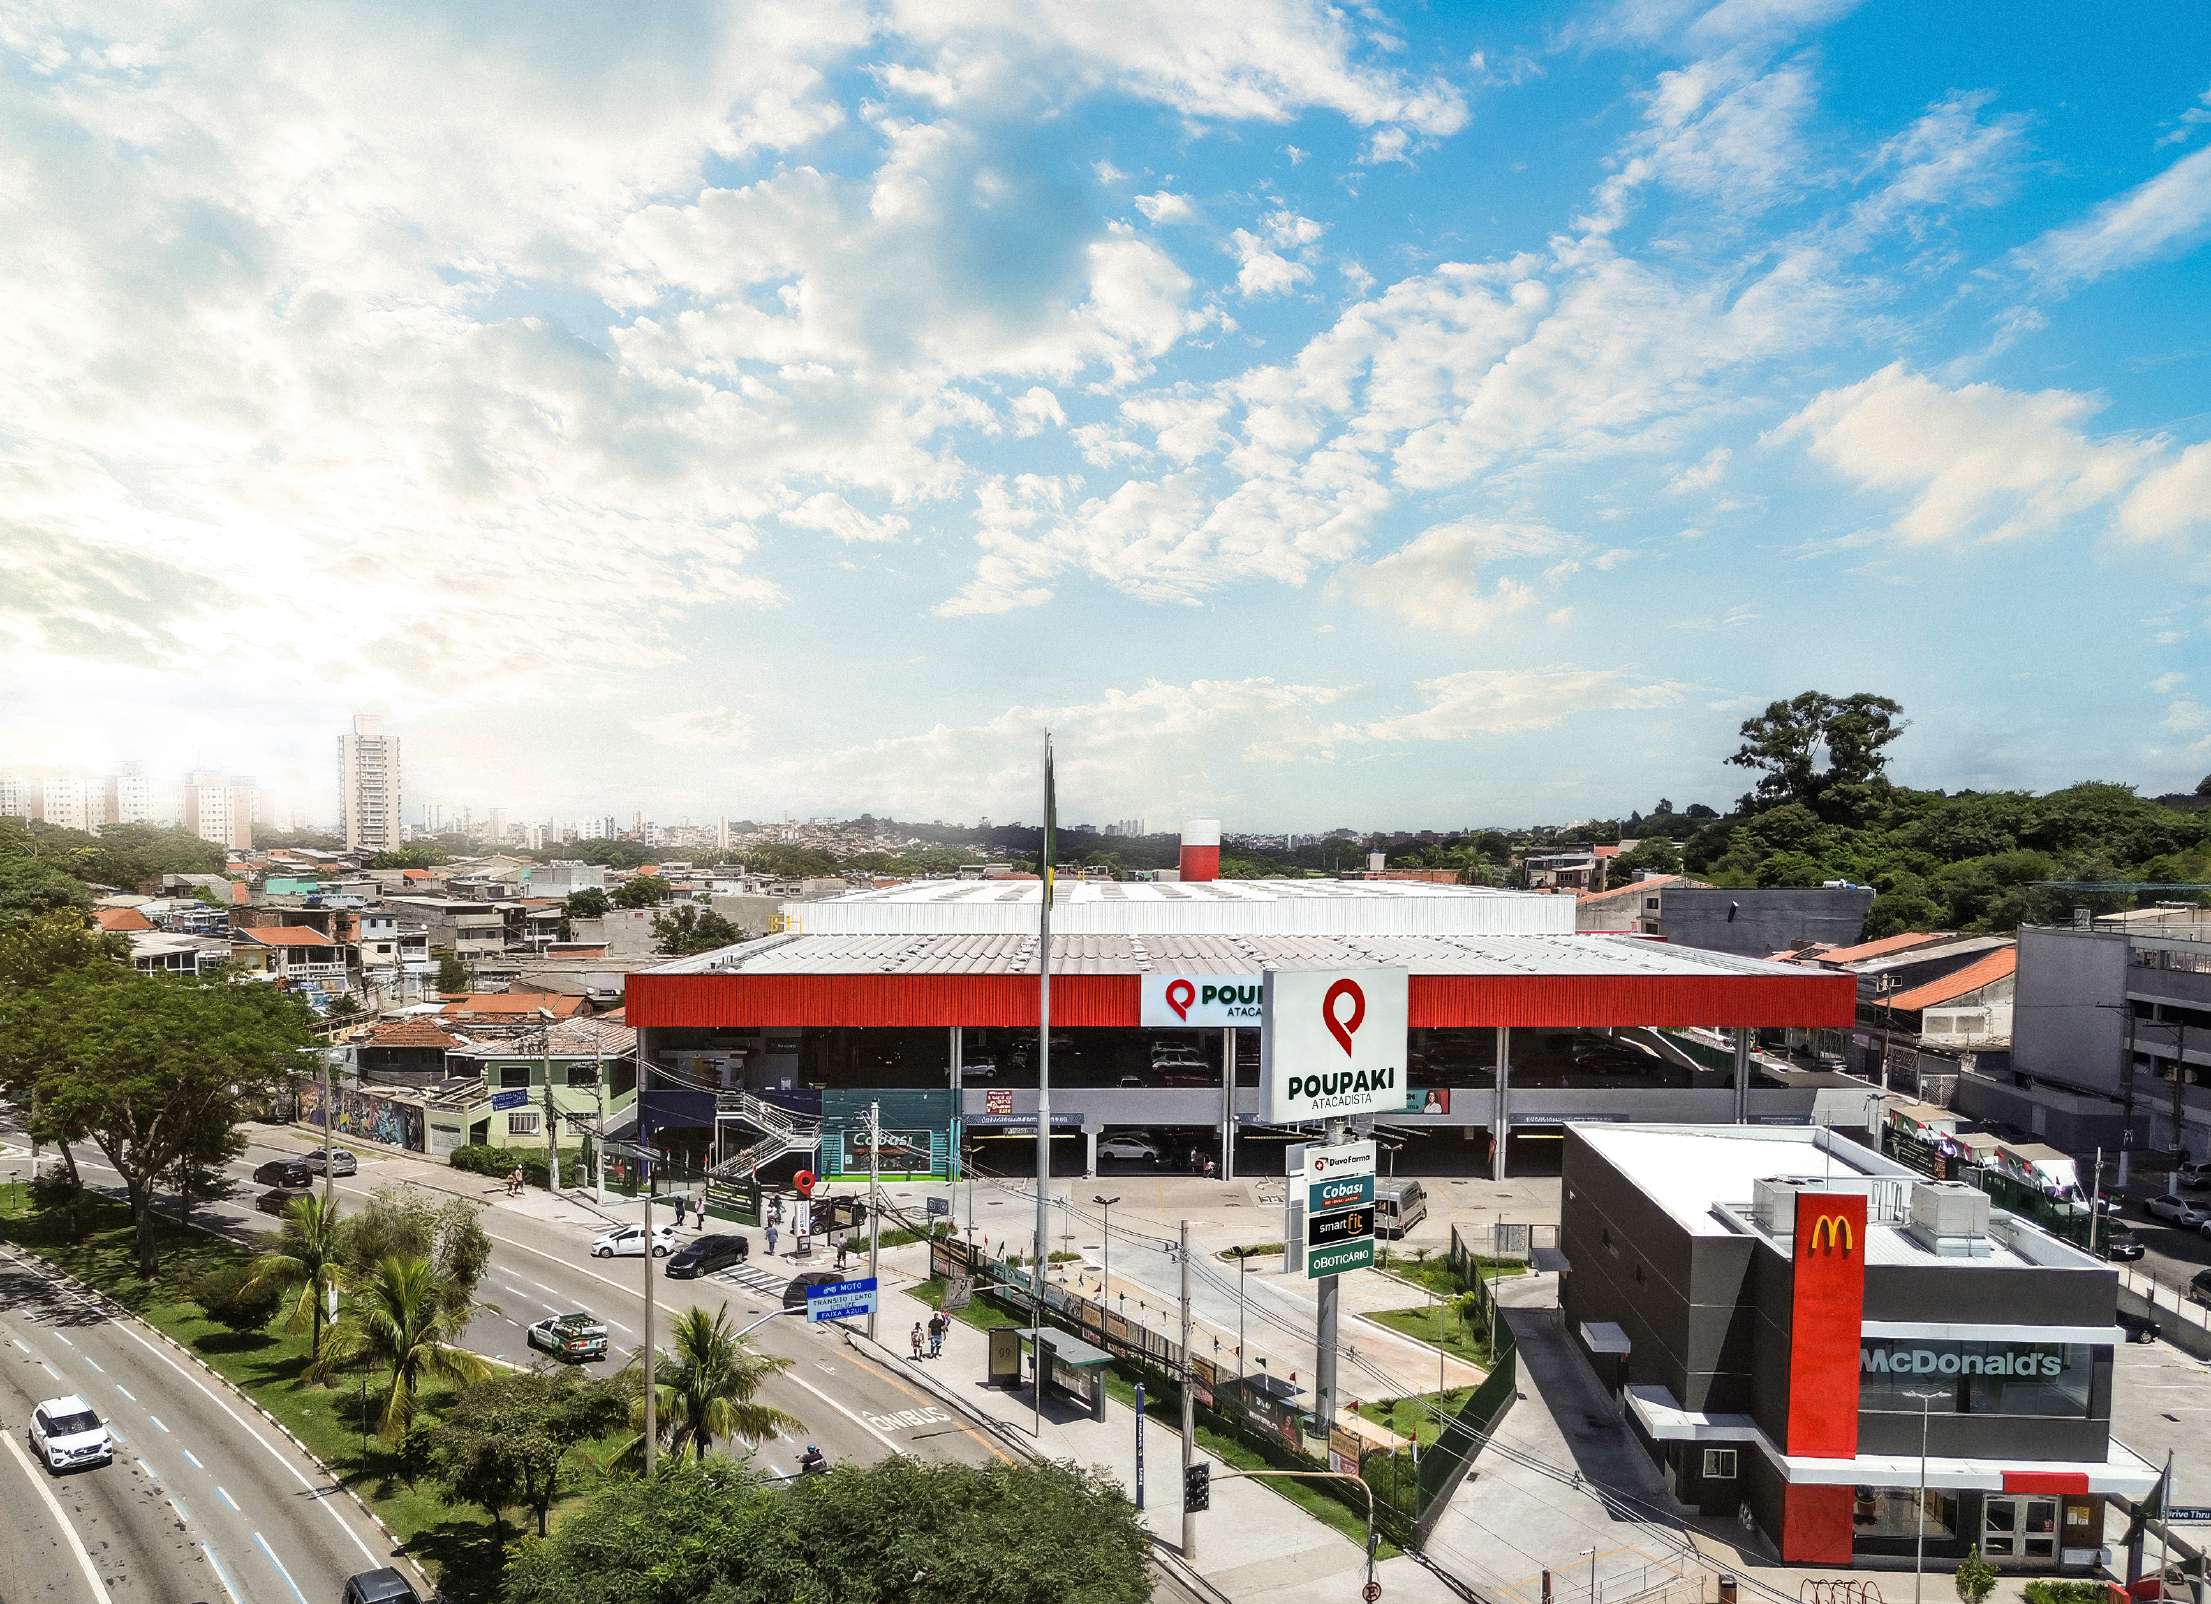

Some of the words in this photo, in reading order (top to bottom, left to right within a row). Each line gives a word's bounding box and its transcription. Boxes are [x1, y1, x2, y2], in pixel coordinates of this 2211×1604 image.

[1288, 1067, 1395, 1100] POUPAKI
[1311, 1093, 1372, 1109] ATACADISTA
[840, 1282, 862, 1291] MOTO
[850, 1293, 872, 1302] LENTO
[821, 1310, 842, 1319] FAIXA
[846, 1307, 864, 1315] AZUL
[1860, 1348, 2061, 1377] McDonald's
[862, 1407, 951, 1431] ÔNIBUS
[2190, 1510, 2210, 1519] Thru
